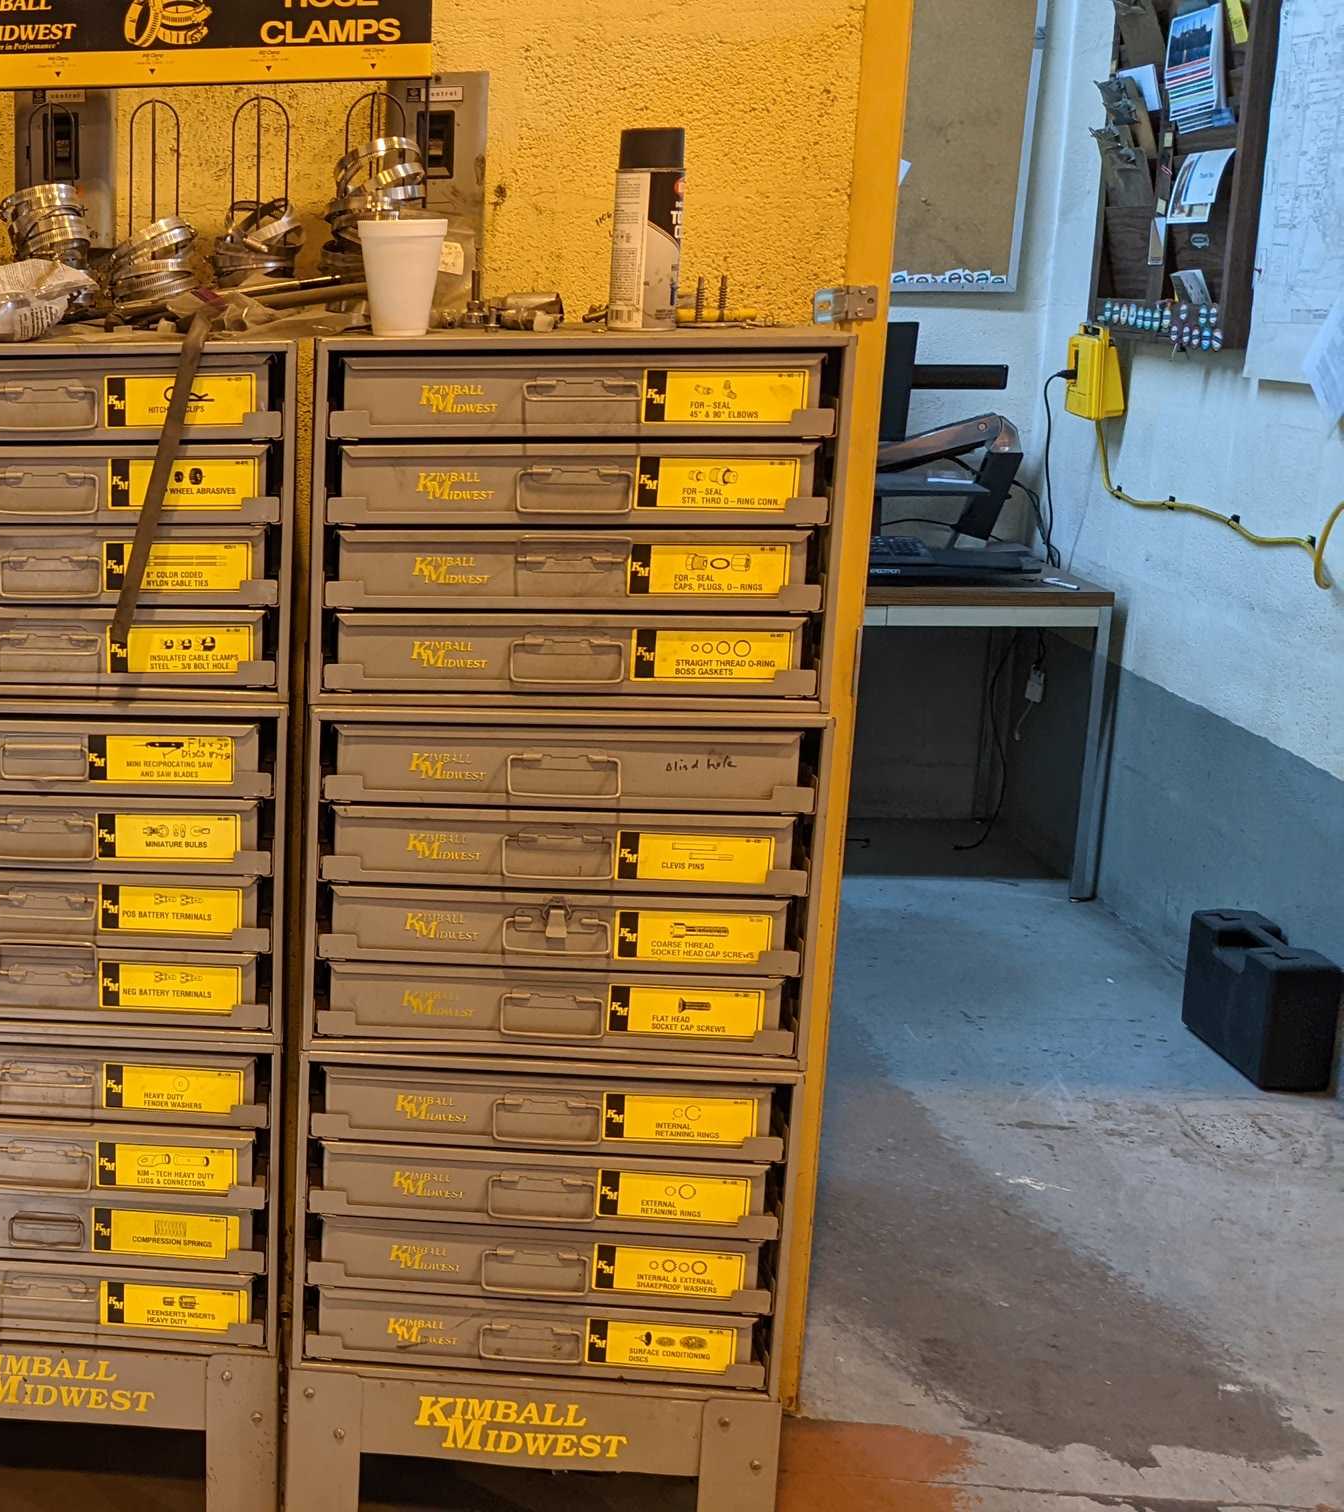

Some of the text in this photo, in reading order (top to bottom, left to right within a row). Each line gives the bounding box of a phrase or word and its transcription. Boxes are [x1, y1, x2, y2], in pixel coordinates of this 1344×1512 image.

[260, 18, 401, 43] CLAMPS
[420, 384, 484, 405] KIMBALL
[432, 395, 498, 414] MIDWEST
[416, 472, 480, 492] KIMBALL
[169, 487, 236, 495] WHEEL ABRASIVES
[428, 480, 495, 501] MIDWEST
[412, 557, 476, 576] KIMBALL
[425, 566, 491, 585] MIDWEST
[150, 654, 185, 662] INSULATED
[747, 660, 776, 668] O-RING
[697, 668, 733, 676] GASKETS
[138, 912, 169, 920] BATTERY
[171, 913, 212, 921] TERMINALS
[651, 940, 681, 948] COARSE
[683, 949, 703, 957] HEAD
[696, 1025, 726, 1033] SCREWS
[171, 1101, 202, 1109] WASHERS
[655, 1130, 696, 1138] RETAINING
[641, 1200, 677, 1208] EXTERNAL
[640, 1207, 680, 1216] RETAINING
[132, 1236, 213, 1248] COMPRESSION SPRINGS
[636, 1282, 717, 1294] SHAKEPROOF WASHERS
[146, 1310, 216, 1320] KEENSERTS INSERTS
[629, 1349, 711, 1361] SURFACE CONDITIONING
[415, 1396, 586, 1428] KIMBALL
[442, 1420, 628, 1458] MIDWEST
